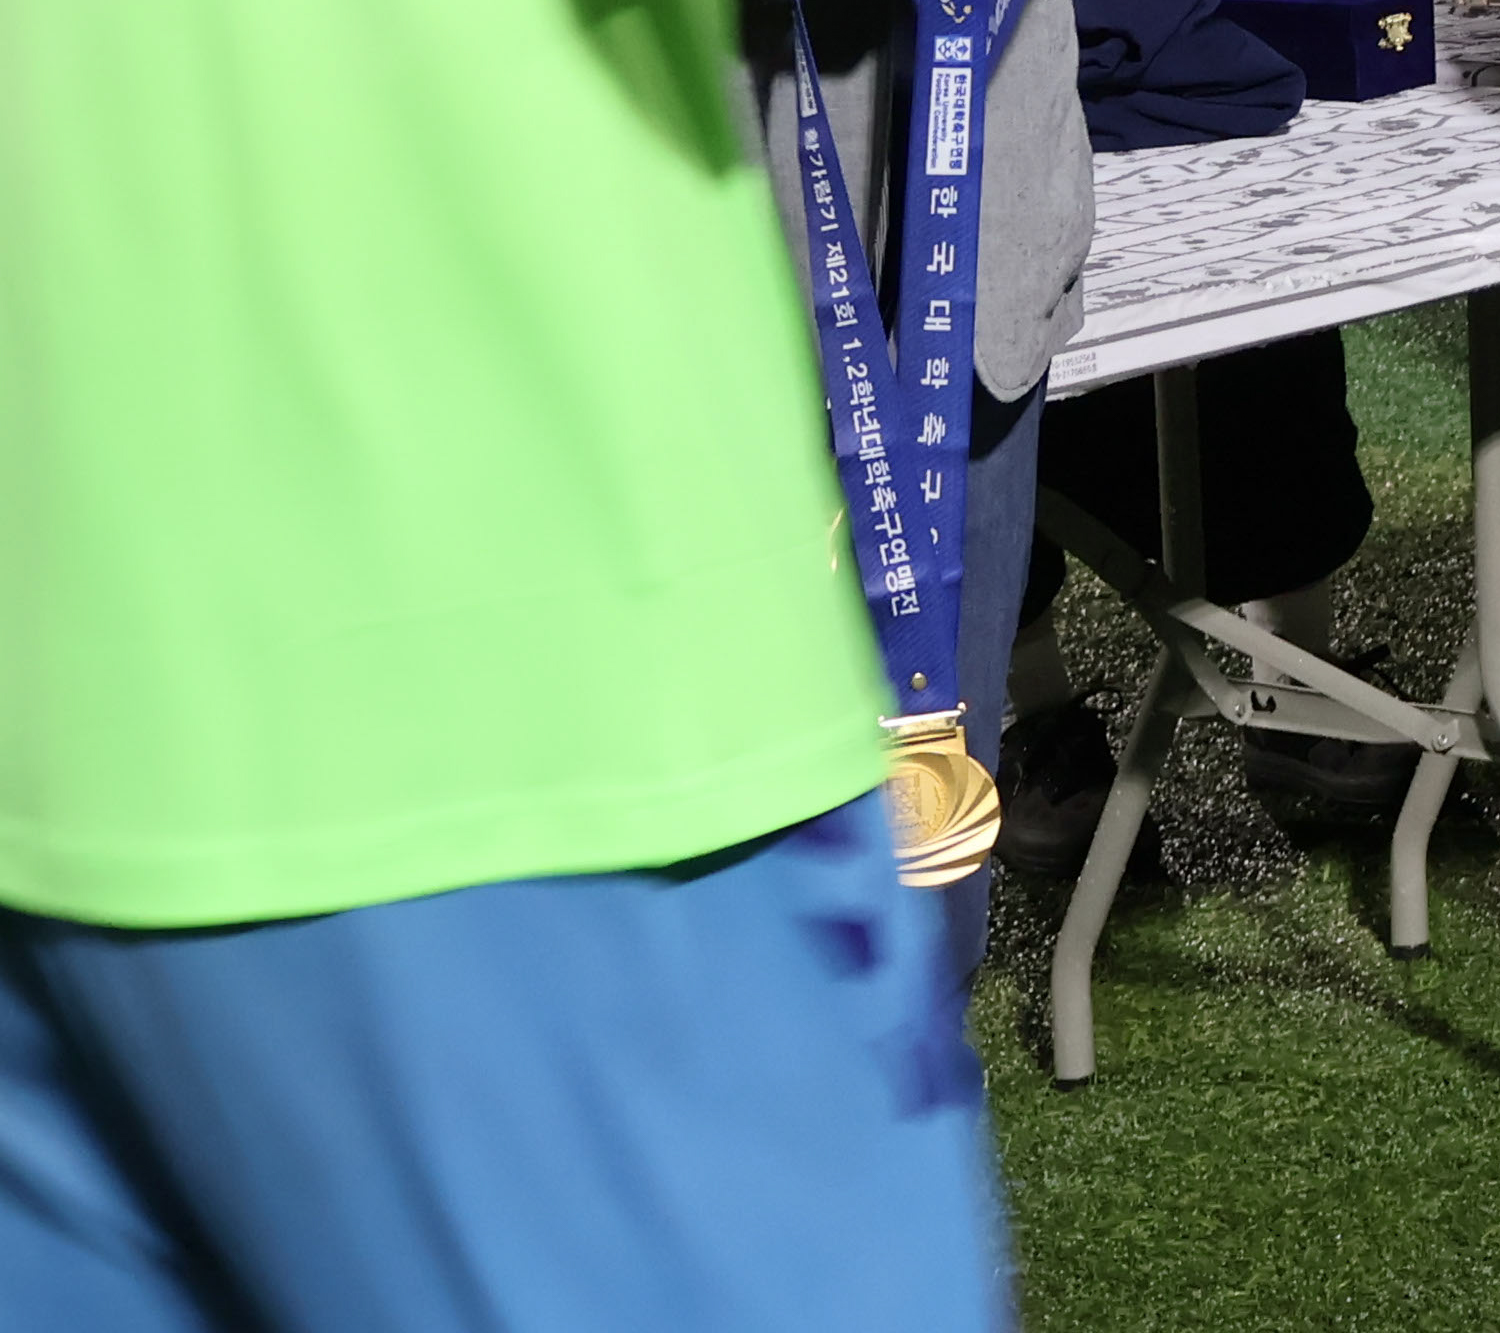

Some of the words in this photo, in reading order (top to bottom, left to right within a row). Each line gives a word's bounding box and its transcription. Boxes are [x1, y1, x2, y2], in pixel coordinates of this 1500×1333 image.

[949, 74, 967, 170] 한국대학축구연맹
[825, 241, 858, 328] 제21회
[916, 185, 958, 545] 한국대학축구
